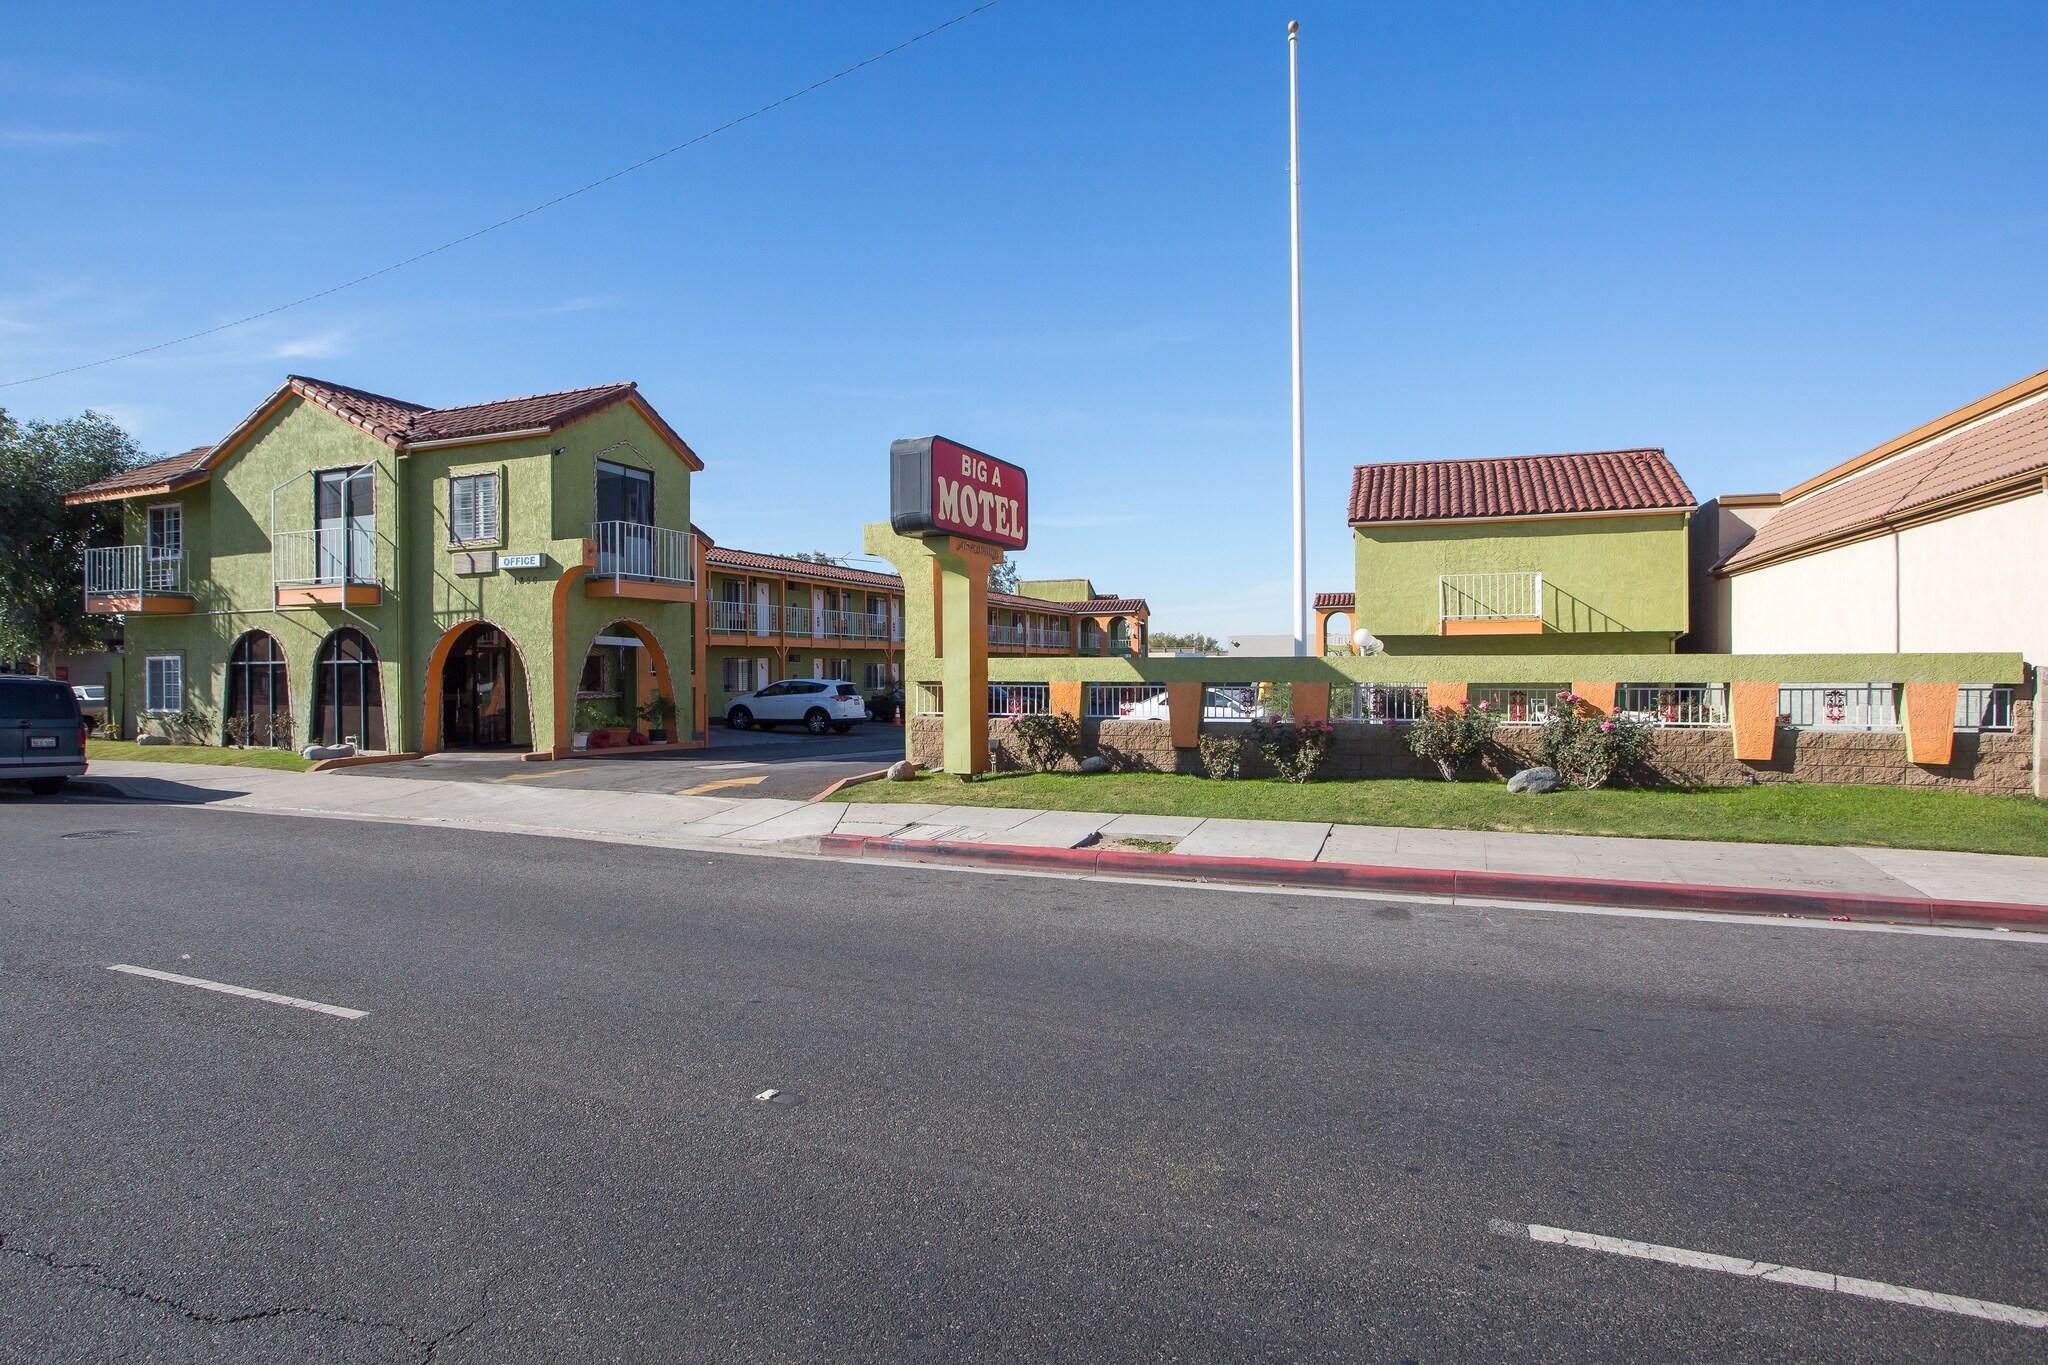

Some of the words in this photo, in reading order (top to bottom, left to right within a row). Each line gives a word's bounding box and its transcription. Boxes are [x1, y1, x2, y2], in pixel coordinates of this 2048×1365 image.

[961, 454, 987, 483] BIG
[991, 466, 1001, 488] A
[937, 476, 1023, 540] MOTEL
[503, 556, 536, 566] OFFICE
